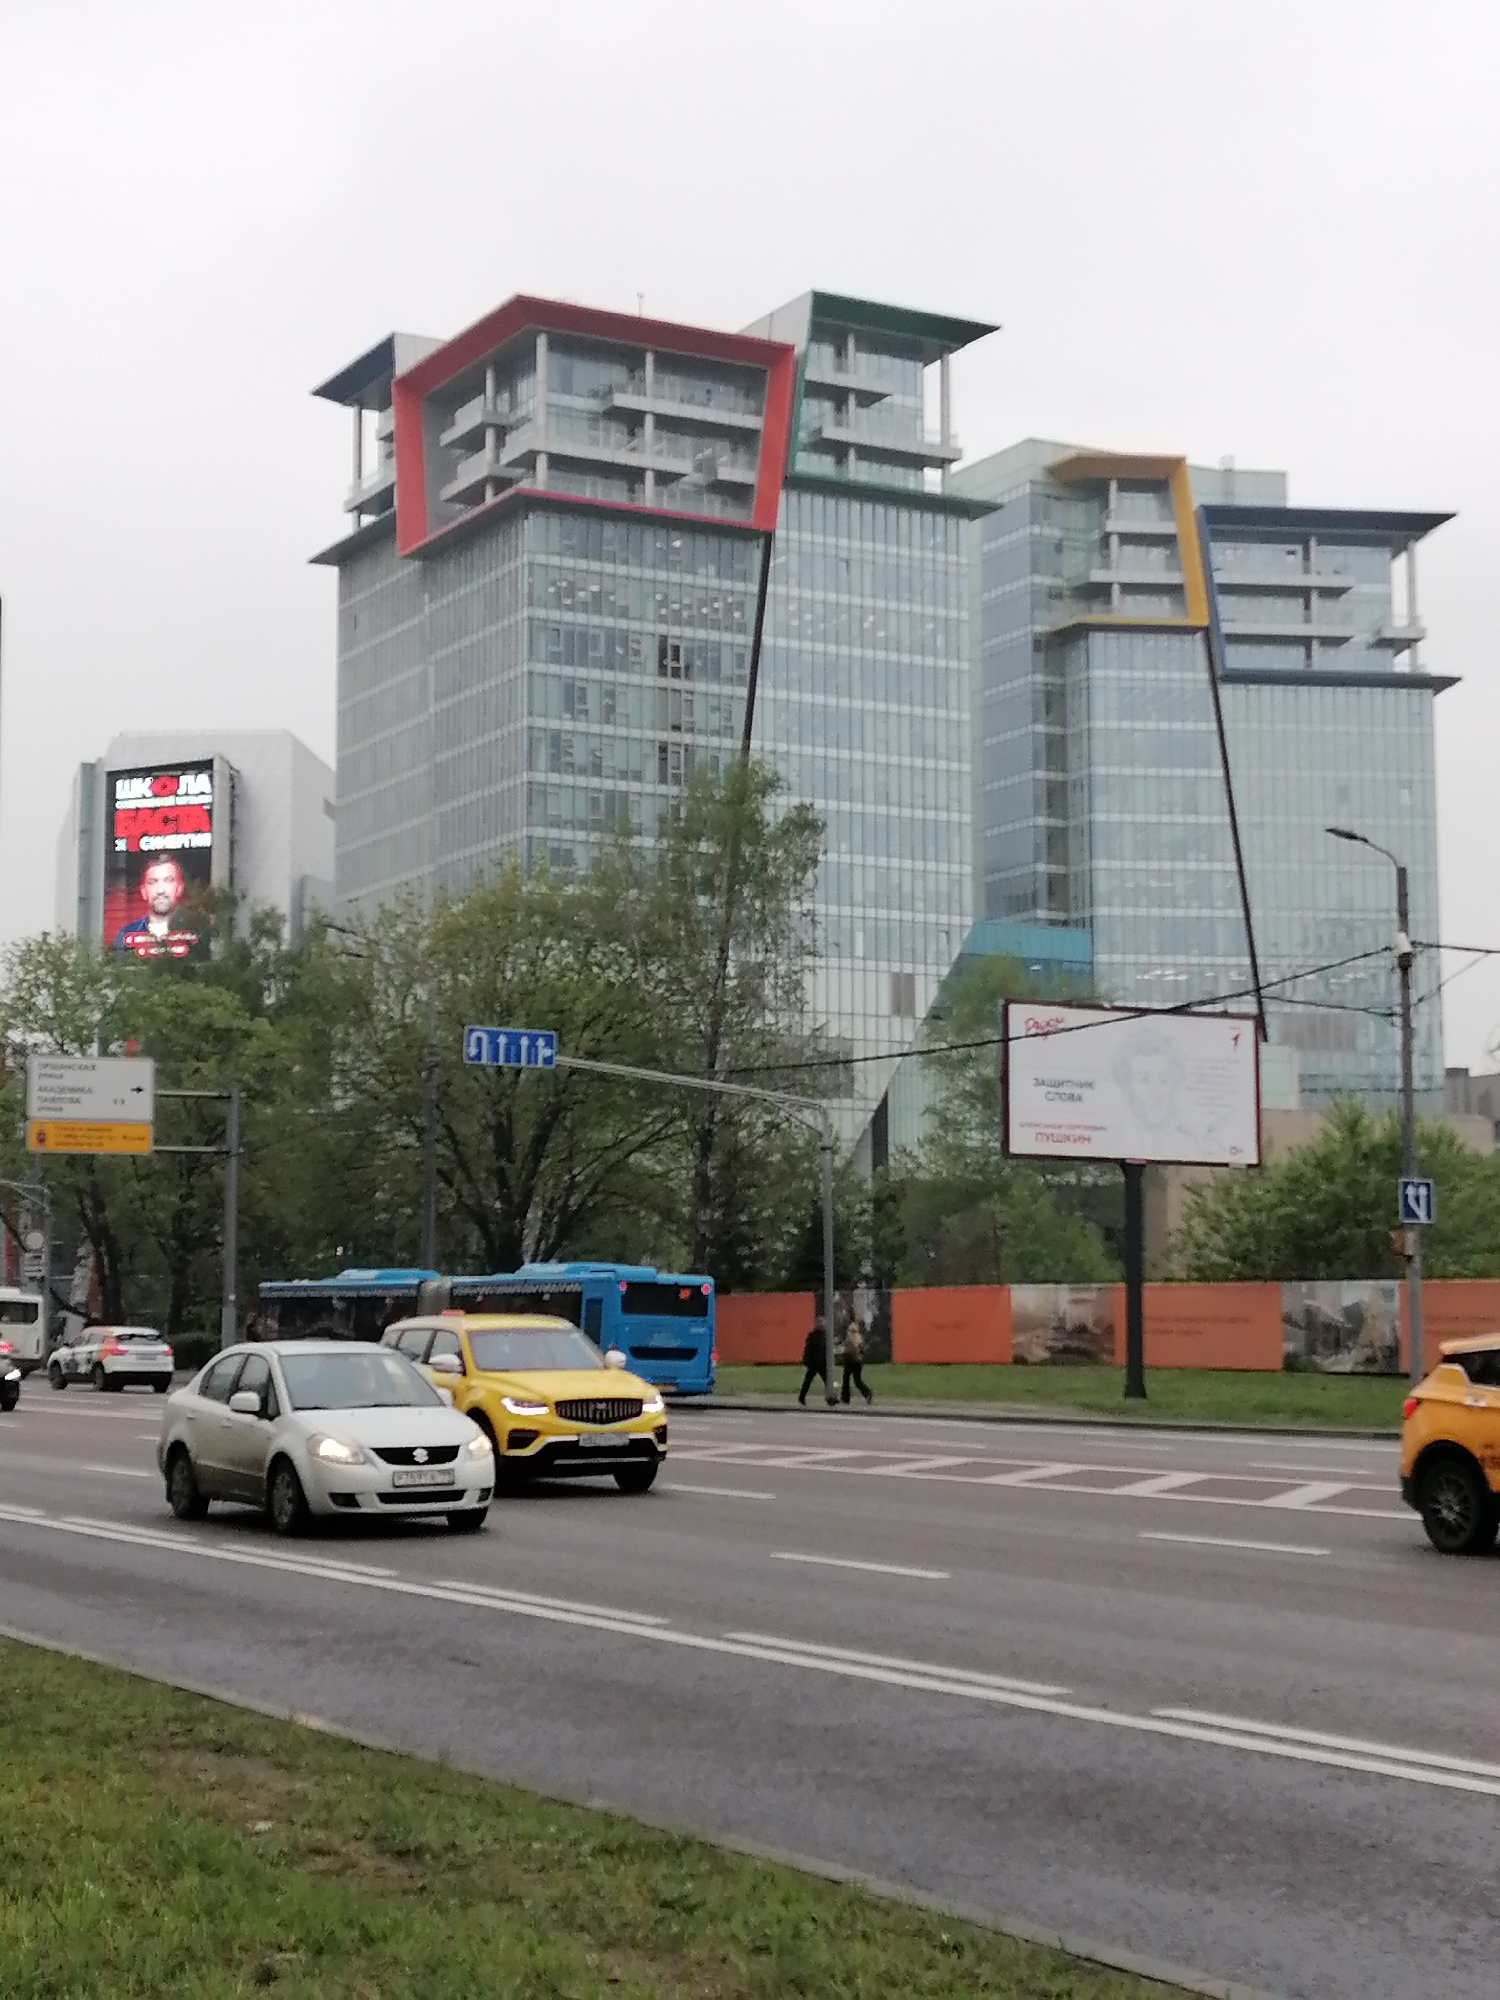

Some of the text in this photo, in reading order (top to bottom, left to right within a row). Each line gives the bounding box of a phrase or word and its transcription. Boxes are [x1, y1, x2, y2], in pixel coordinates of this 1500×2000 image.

[115, 774, 212, 799] ШКОЛА
[1032, 1078, 1095, 1090] ЗАЩИТНИК
[1044, 1091, 1082, 1103] СЛОВА
[1035, 1132, 1091, 1144] ПУШКИН
